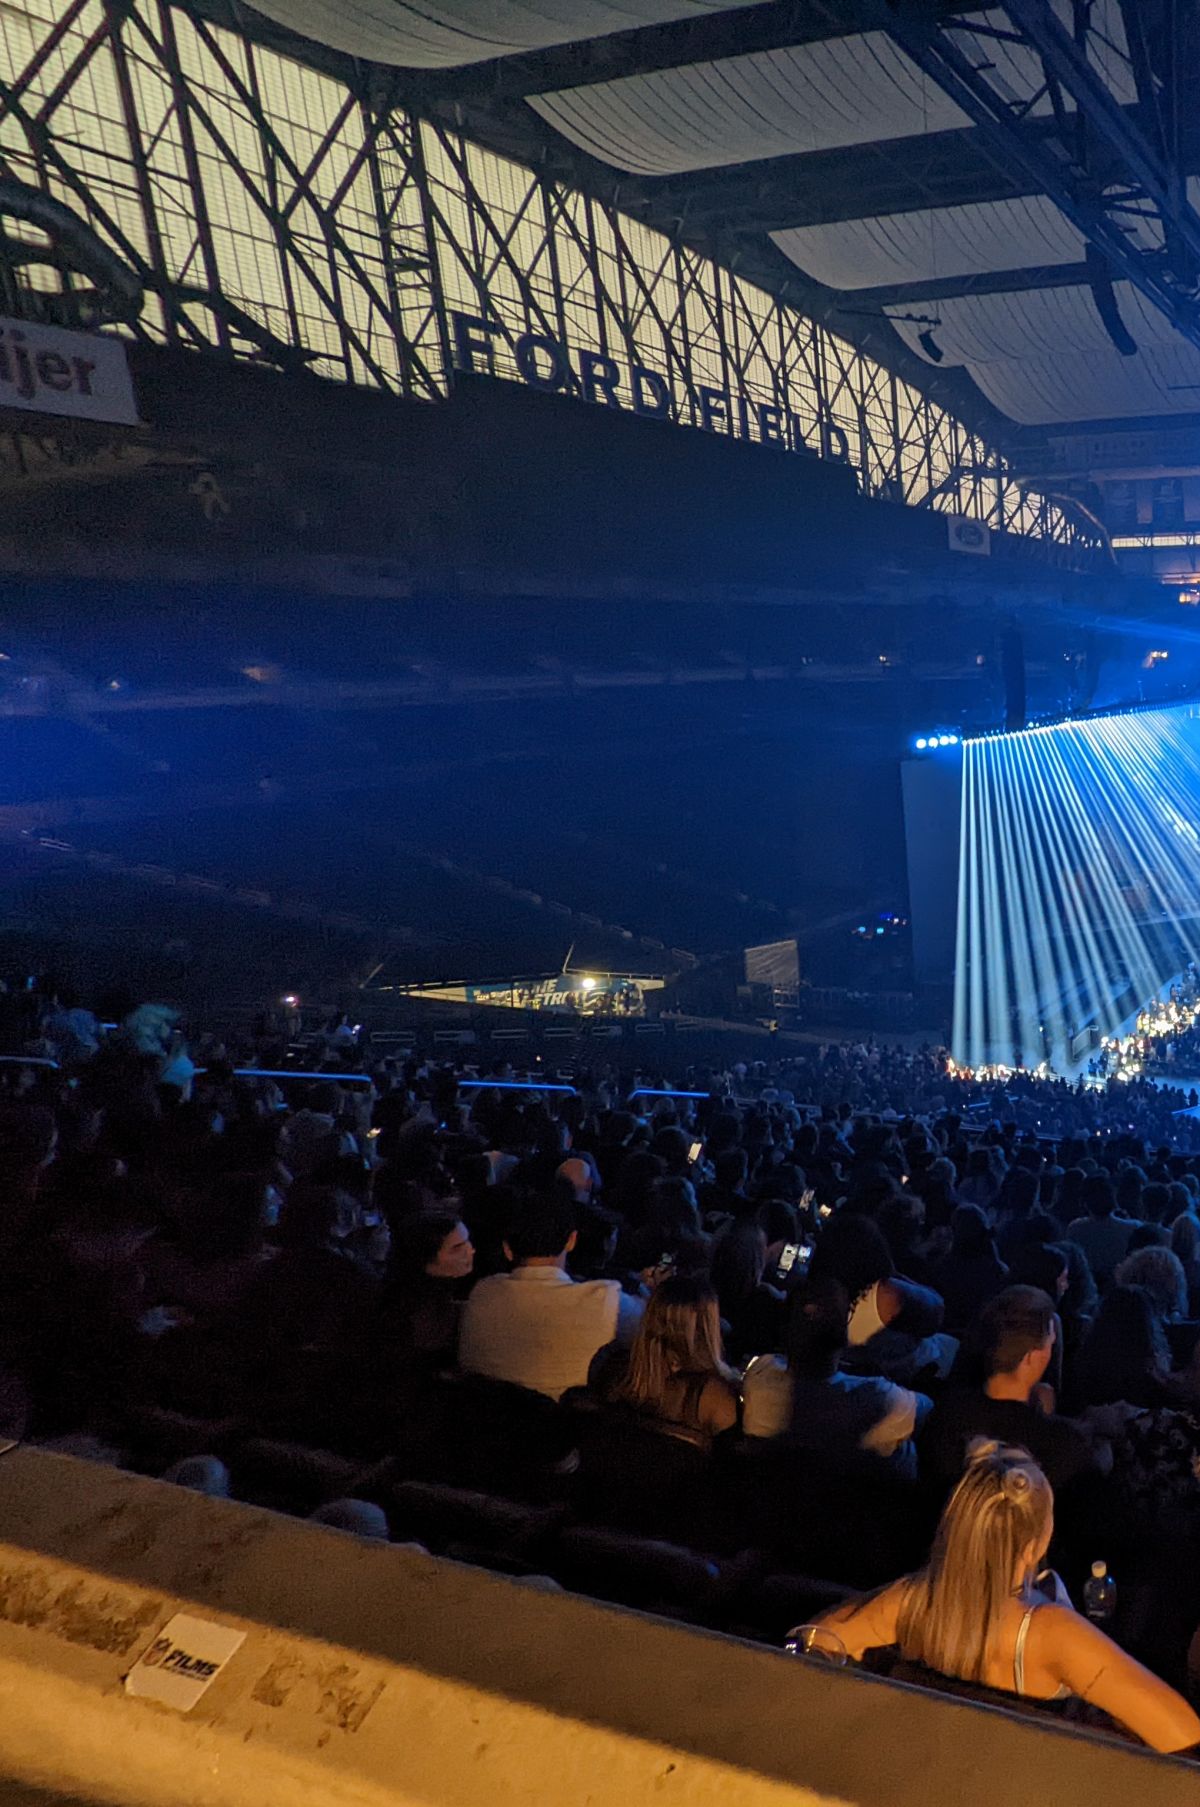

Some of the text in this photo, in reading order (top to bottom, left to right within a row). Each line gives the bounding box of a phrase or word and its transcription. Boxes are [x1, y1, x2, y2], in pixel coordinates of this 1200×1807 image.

[451, 311, 849, 465] FORD FIELD
[164, 1649, 220, 1676] FILMS
